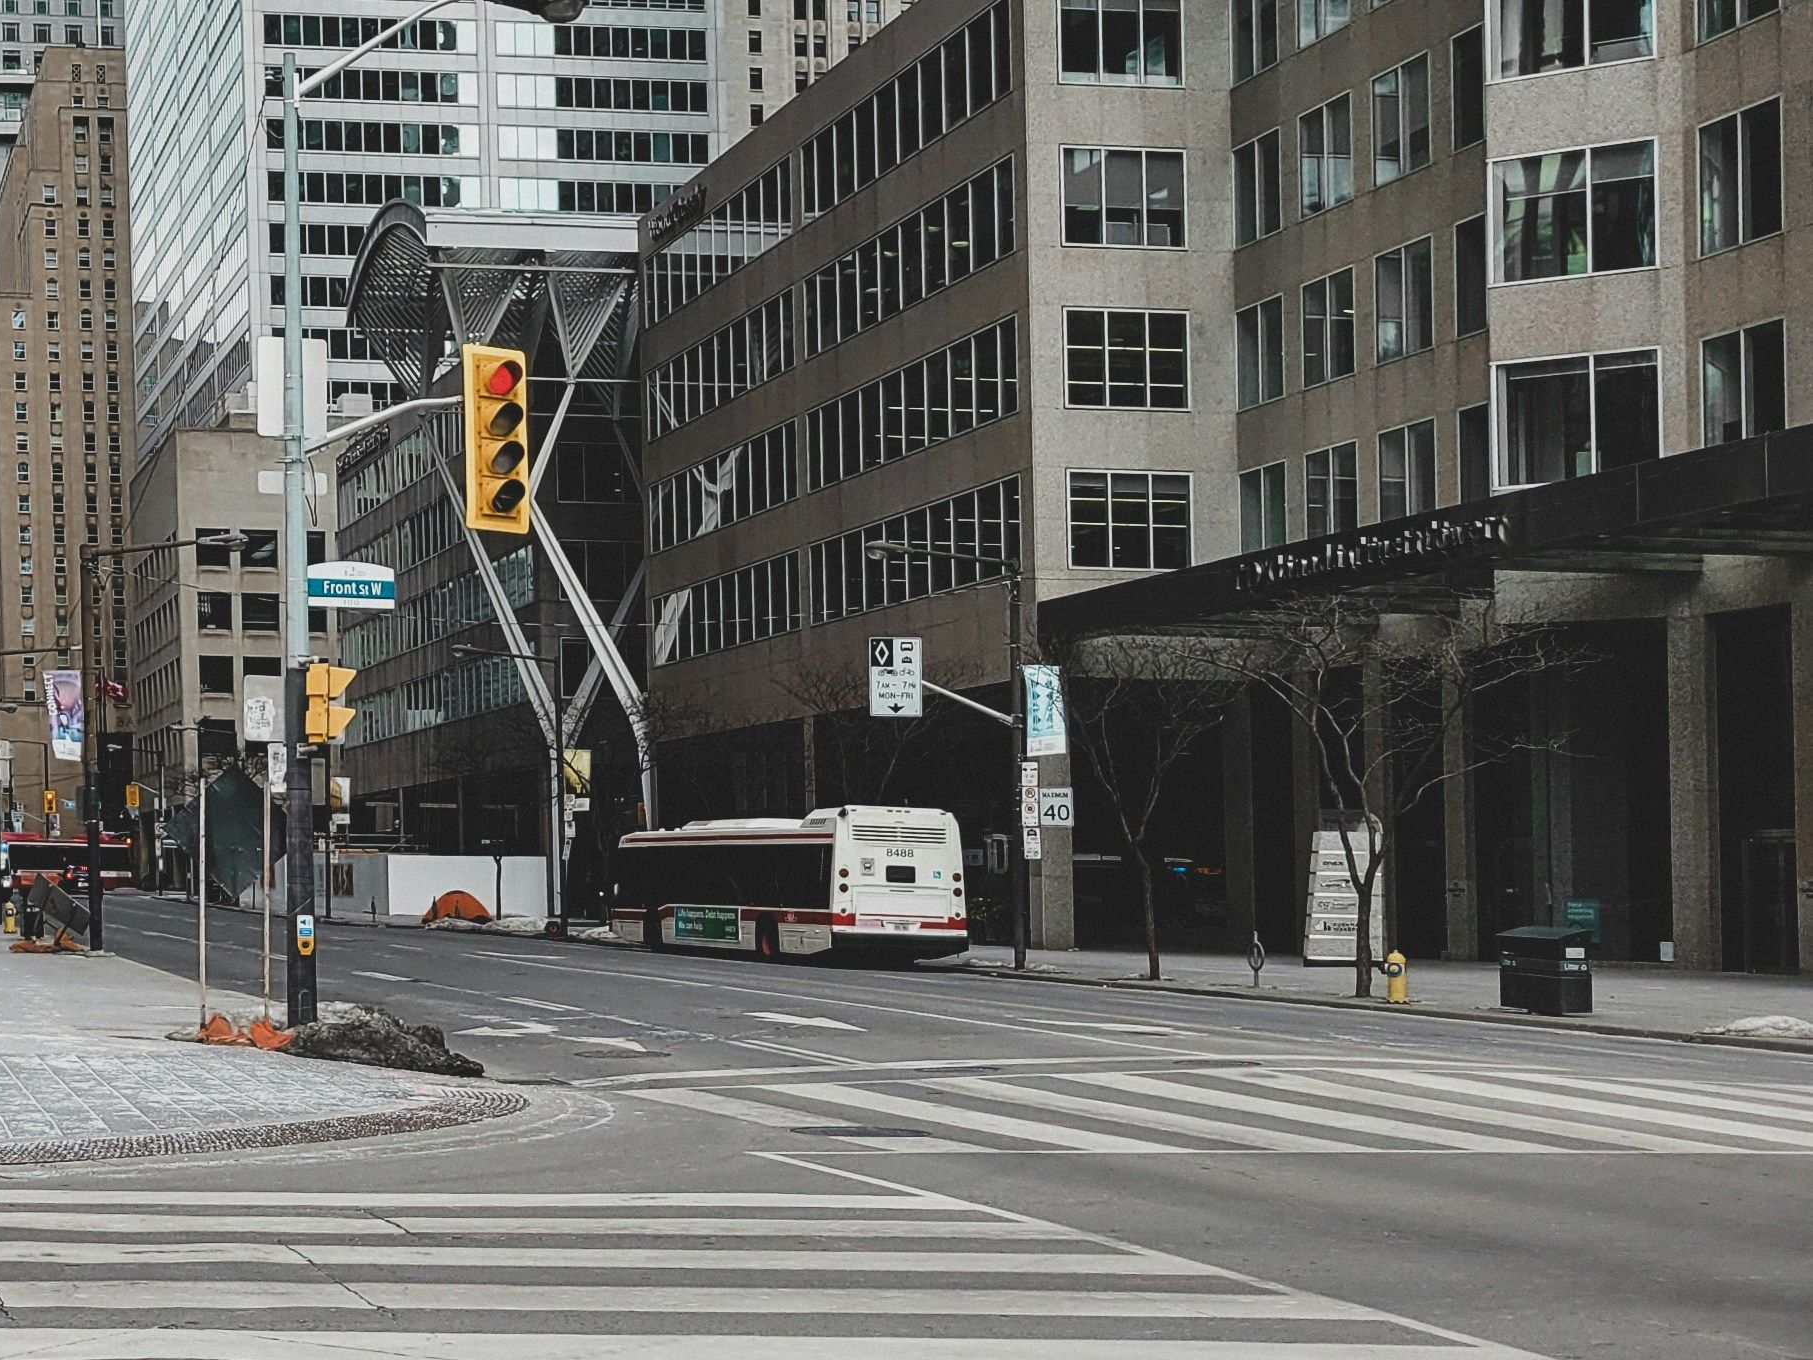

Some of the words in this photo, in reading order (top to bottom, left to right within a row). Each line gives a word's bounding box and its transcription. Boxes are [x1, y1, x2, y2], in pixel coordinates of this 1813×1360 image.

[323, 581, 357, 596] Front
[359, 584, 369, 596] St
[371, 582, 382, 596] W
[43, 672, 58, 716] CONNECT
[878, 692, 914, 700] MON-FRI
[1043, 804, 1070, 821] 40
[886, 848, 914, 858] 8488
